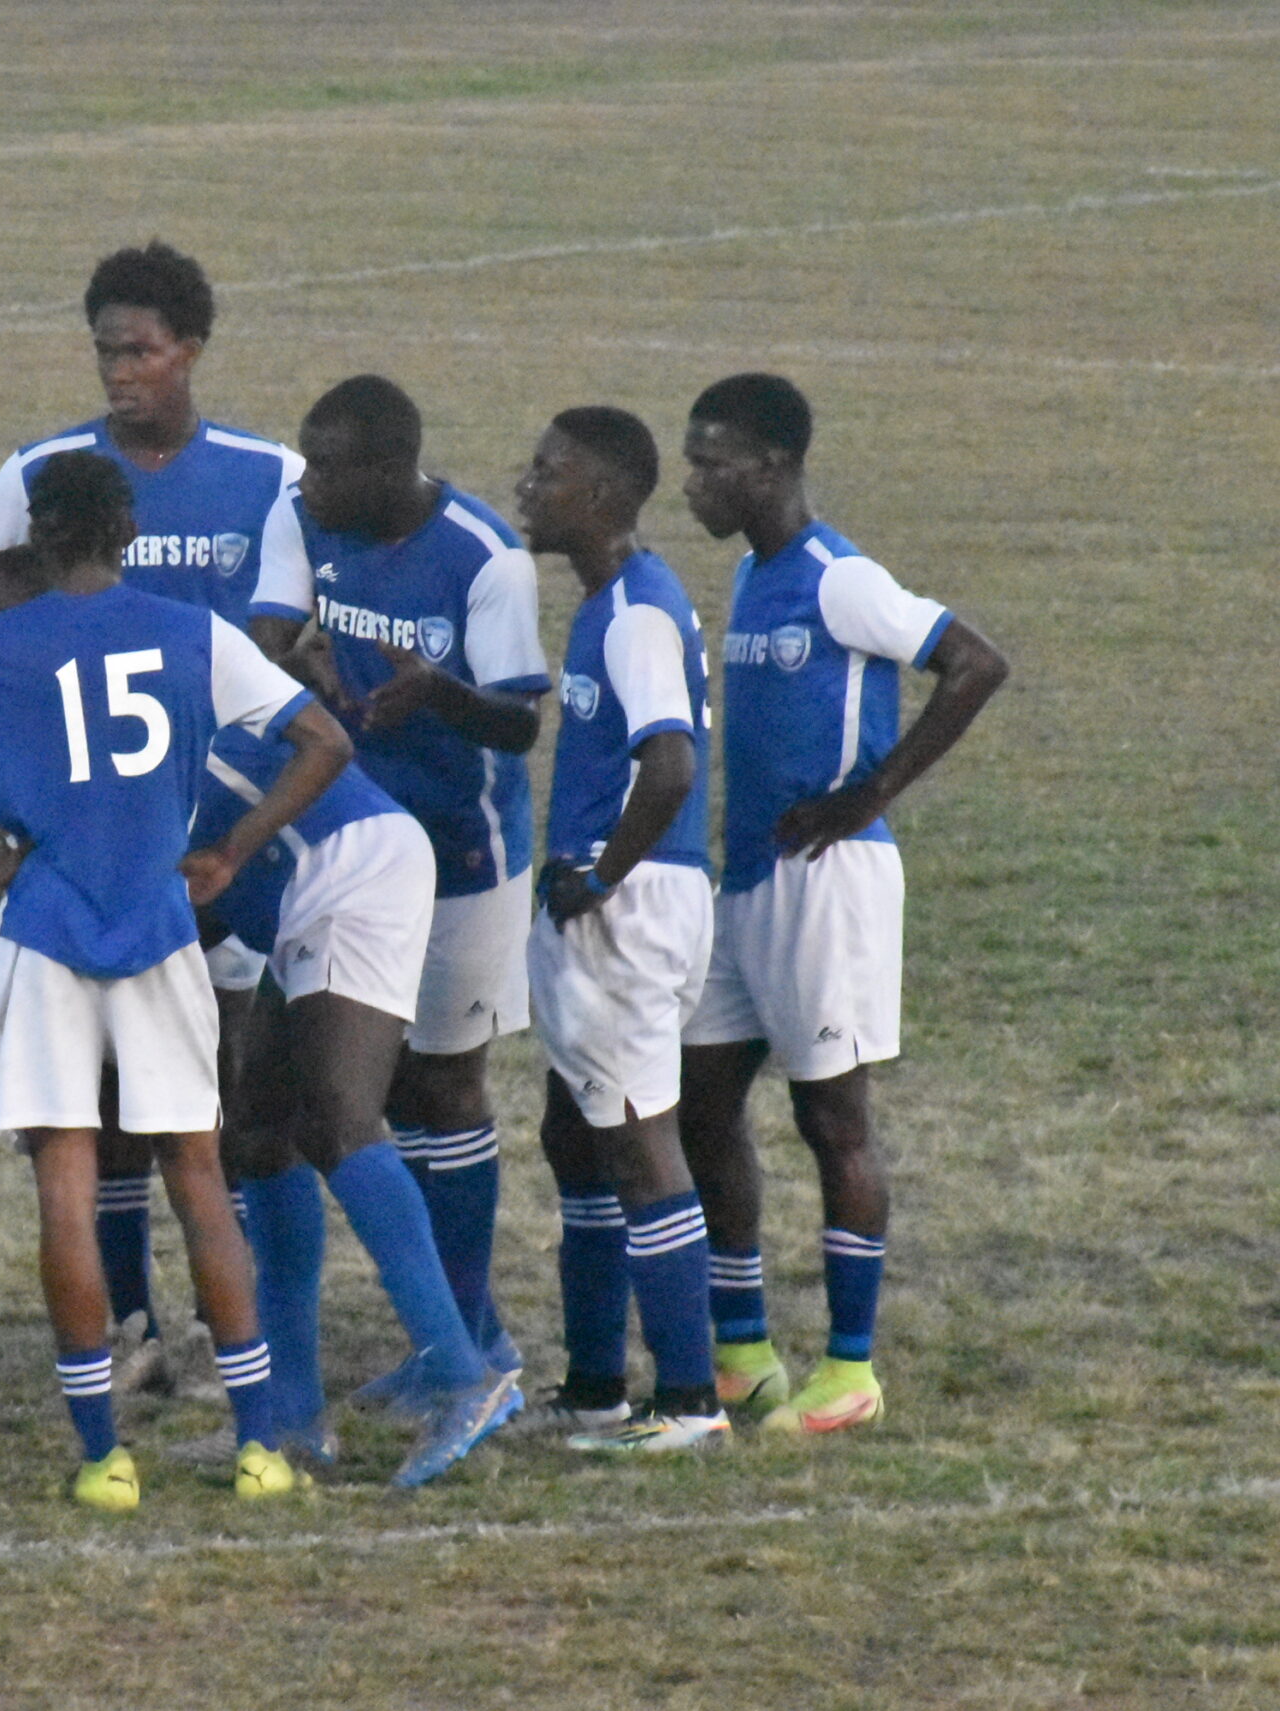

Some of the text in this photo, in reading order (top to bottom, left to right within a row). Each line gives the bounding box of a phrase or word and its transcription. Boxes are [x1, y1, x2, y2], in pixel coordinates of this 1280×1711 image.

[122, 535, 210, 567] TER'S FC
[393, 618, 415, 650] FC
[55, 648, 170, 783] 15
